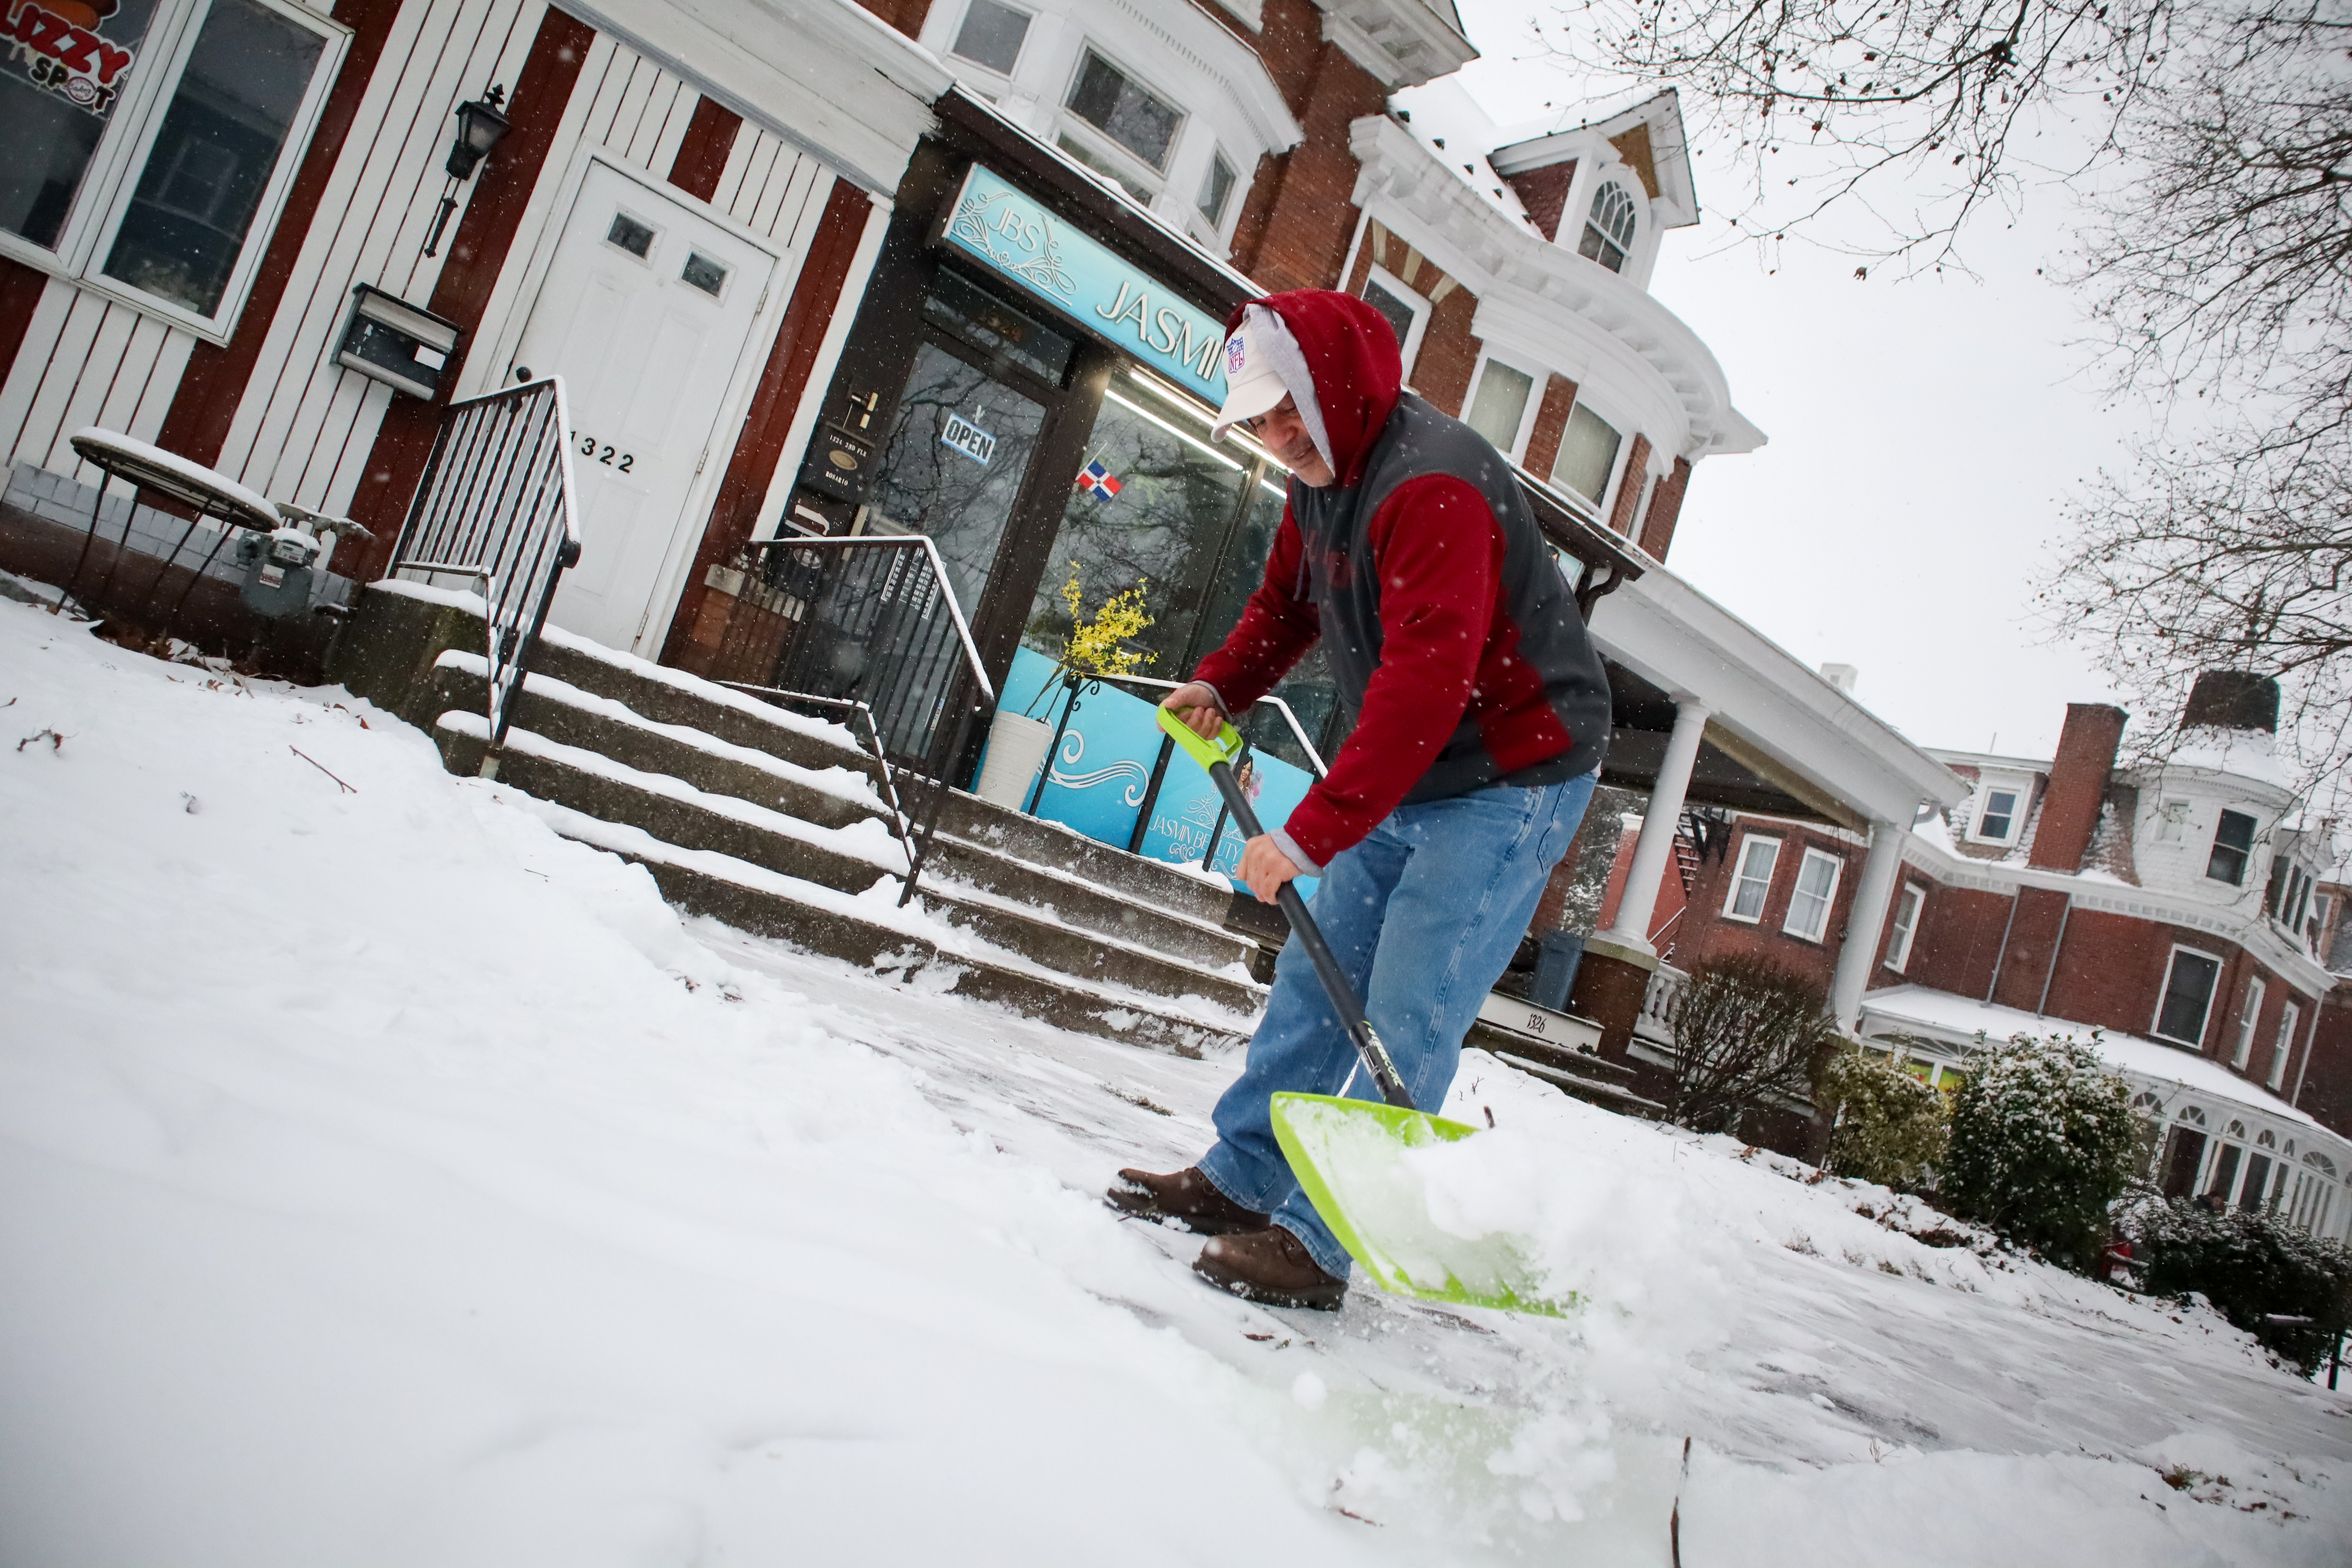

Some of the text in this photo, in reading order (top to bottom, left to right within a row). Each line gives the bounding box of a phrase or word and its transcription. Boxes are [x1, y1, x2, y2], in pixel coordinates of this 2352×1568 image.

[31, 57, 114, 110] SPOT
[987, 208, 1041, 252] JBS
[1096, 281, 1224, 382] JASMI
[1230, 352, 1243, 371] NFL
[829, 434, 867, 457] 1324 2ND FLR
[946, 419, 992, 460] OPEN
[825, 471, 848, 486] ROSARIO
[1149, 815, 1242, 862] JASMIN BEUTY
[1527, 1013, 1547, 1033] 1326
